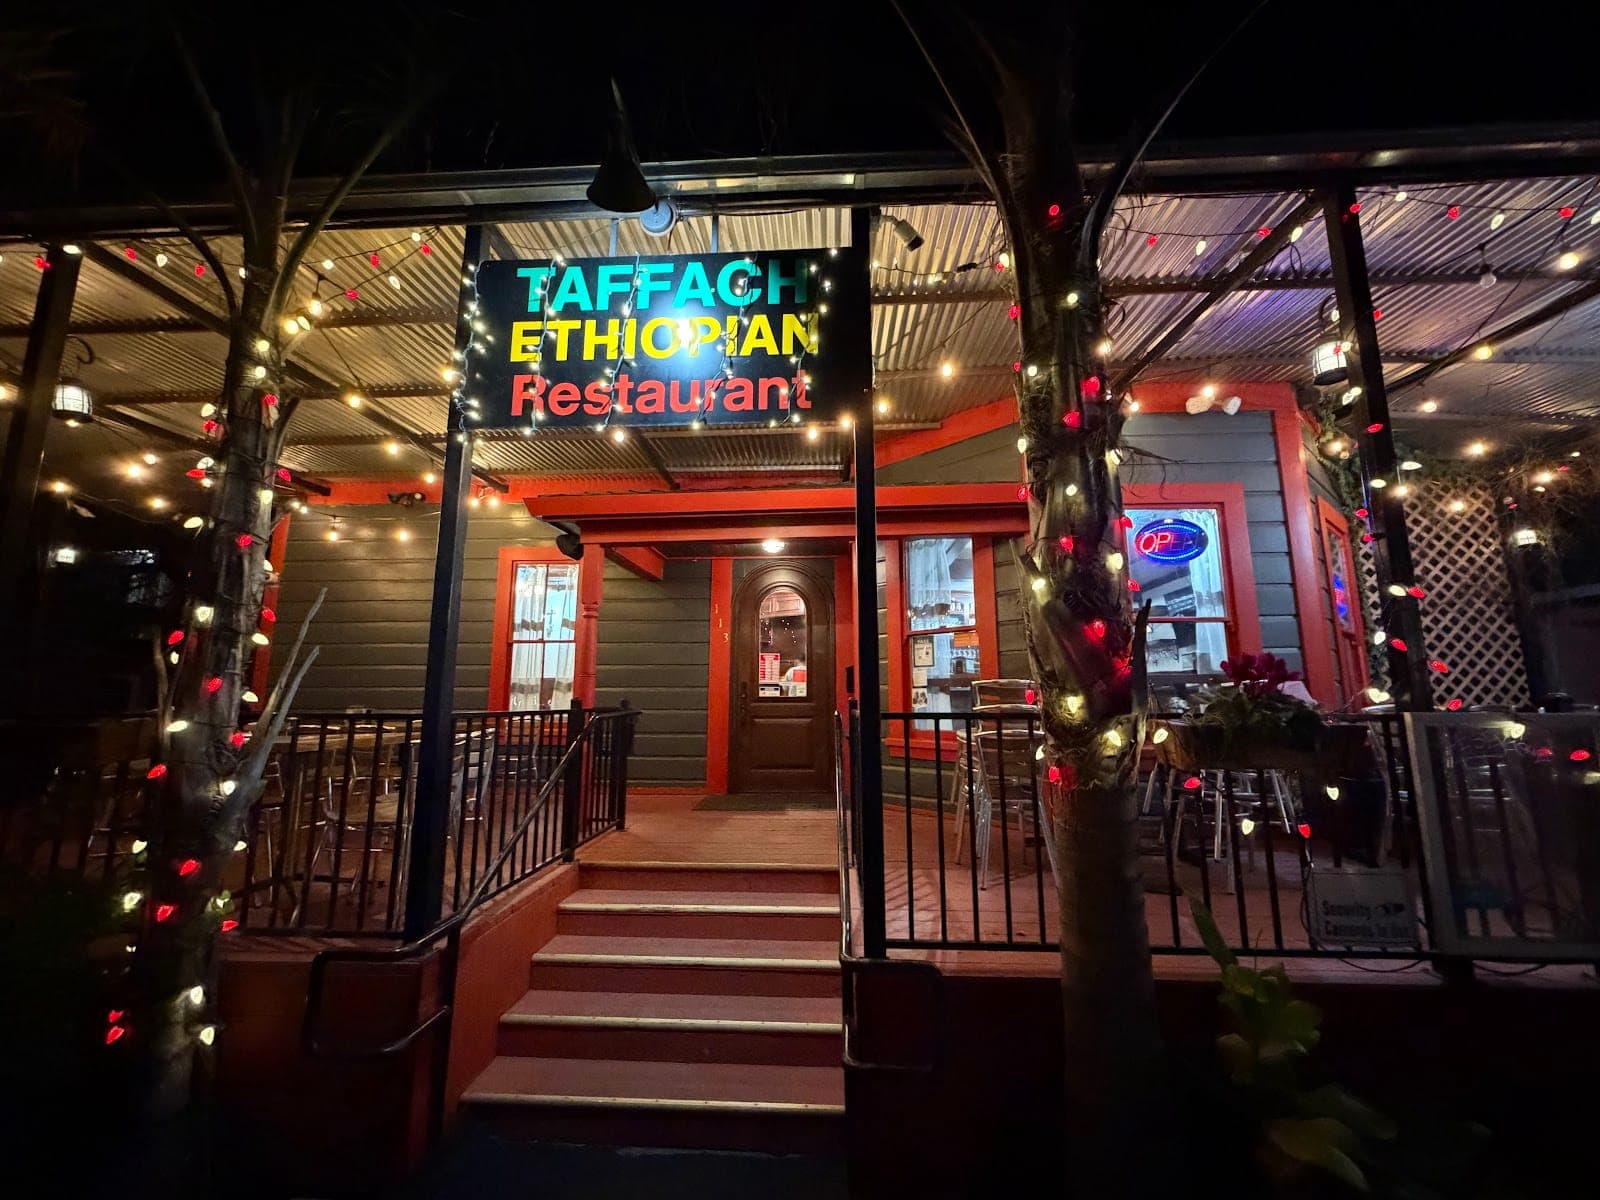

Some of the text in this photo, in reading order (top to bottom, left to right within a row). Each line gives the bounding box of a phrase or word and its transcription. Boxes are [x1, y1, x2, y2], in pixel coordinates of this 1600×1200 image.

[516, 258, 808, 314] TAFFACH
[509, 313, 819, 363] ETHIOPIAN
[510, 370, 812, 417] Restaurant
